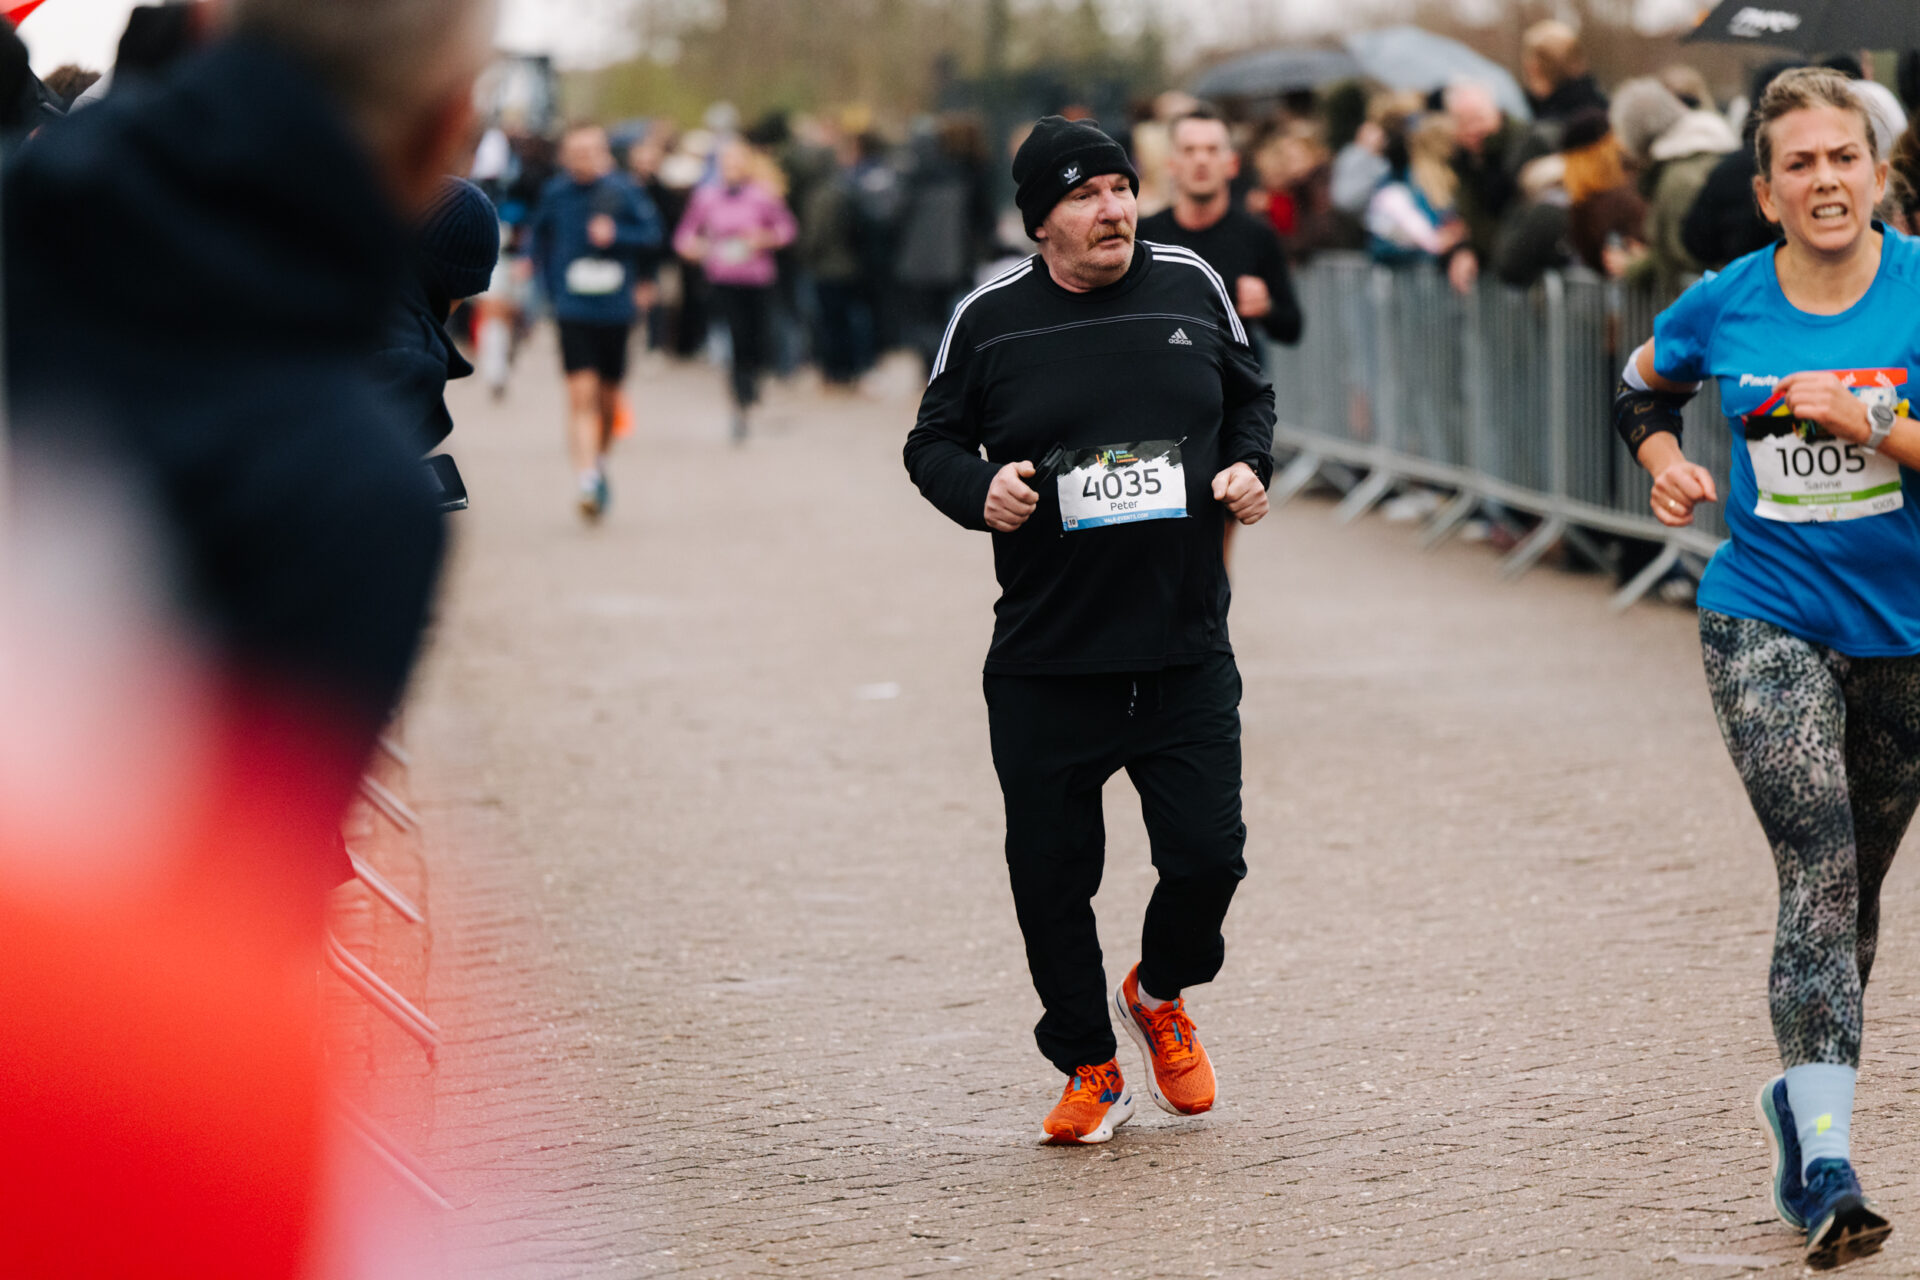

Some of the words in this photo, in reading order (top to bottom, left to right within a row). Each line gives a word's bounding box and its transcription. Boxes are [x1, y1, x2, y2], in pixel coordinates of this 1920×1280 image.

[1168, 338, 1192, 346] adidas
[1776, 444, 1866, 477] 1005
[1082, 468, 1162, 501] 4035
[1804, 479, 1842, 491] Sanne
[1110, 500, 1138, 511] Peter
